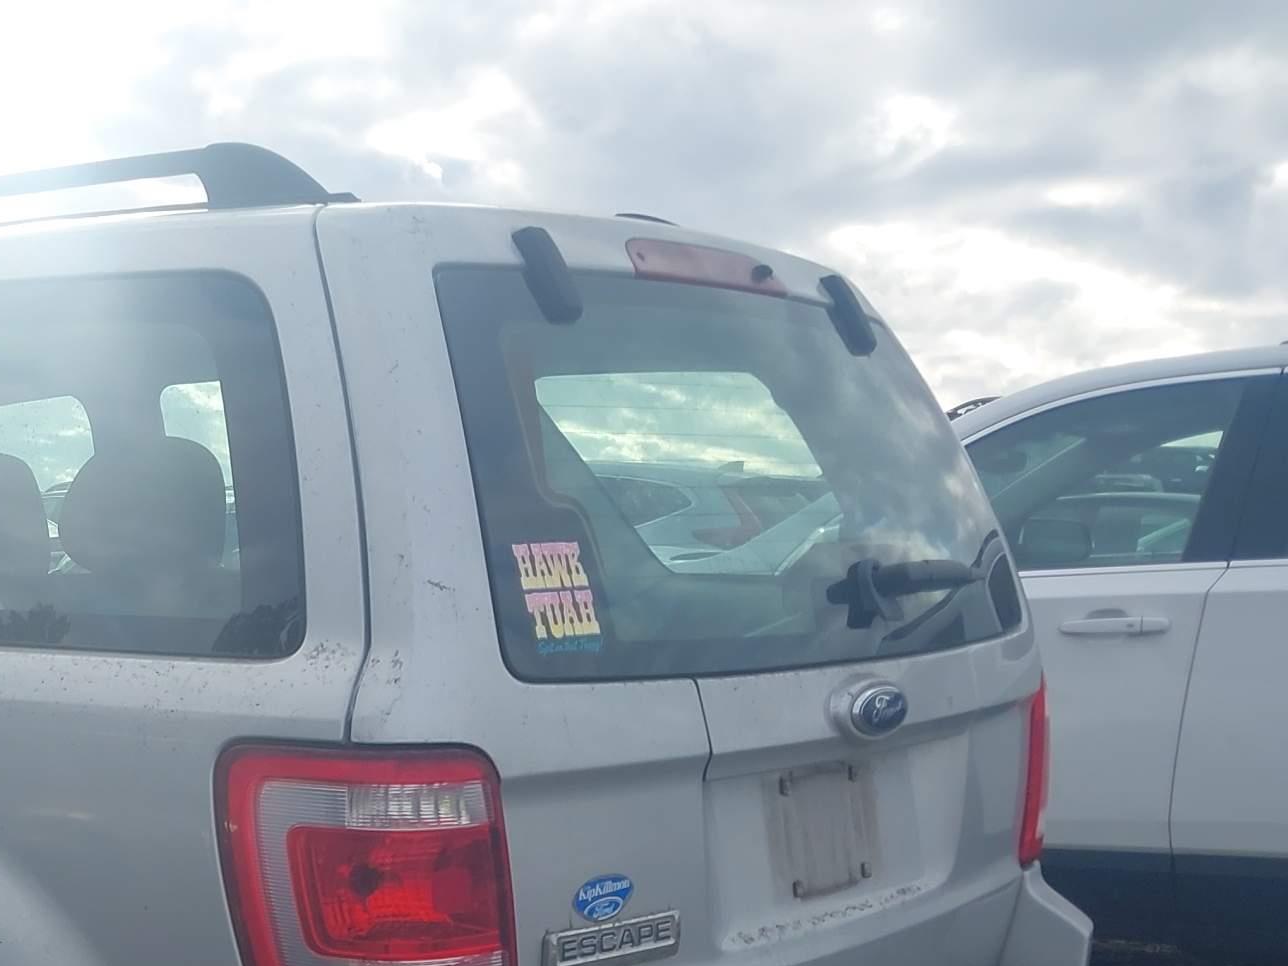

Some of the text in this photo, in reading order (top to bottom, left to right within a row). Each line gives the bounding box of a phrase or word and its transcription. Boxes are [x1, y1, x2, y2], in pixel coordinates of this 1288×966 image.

[511, 541, 589, 590] HAWK
[524, 589, 601, 640] TUAH
[561, 919, 673, 962] ESCAPE
